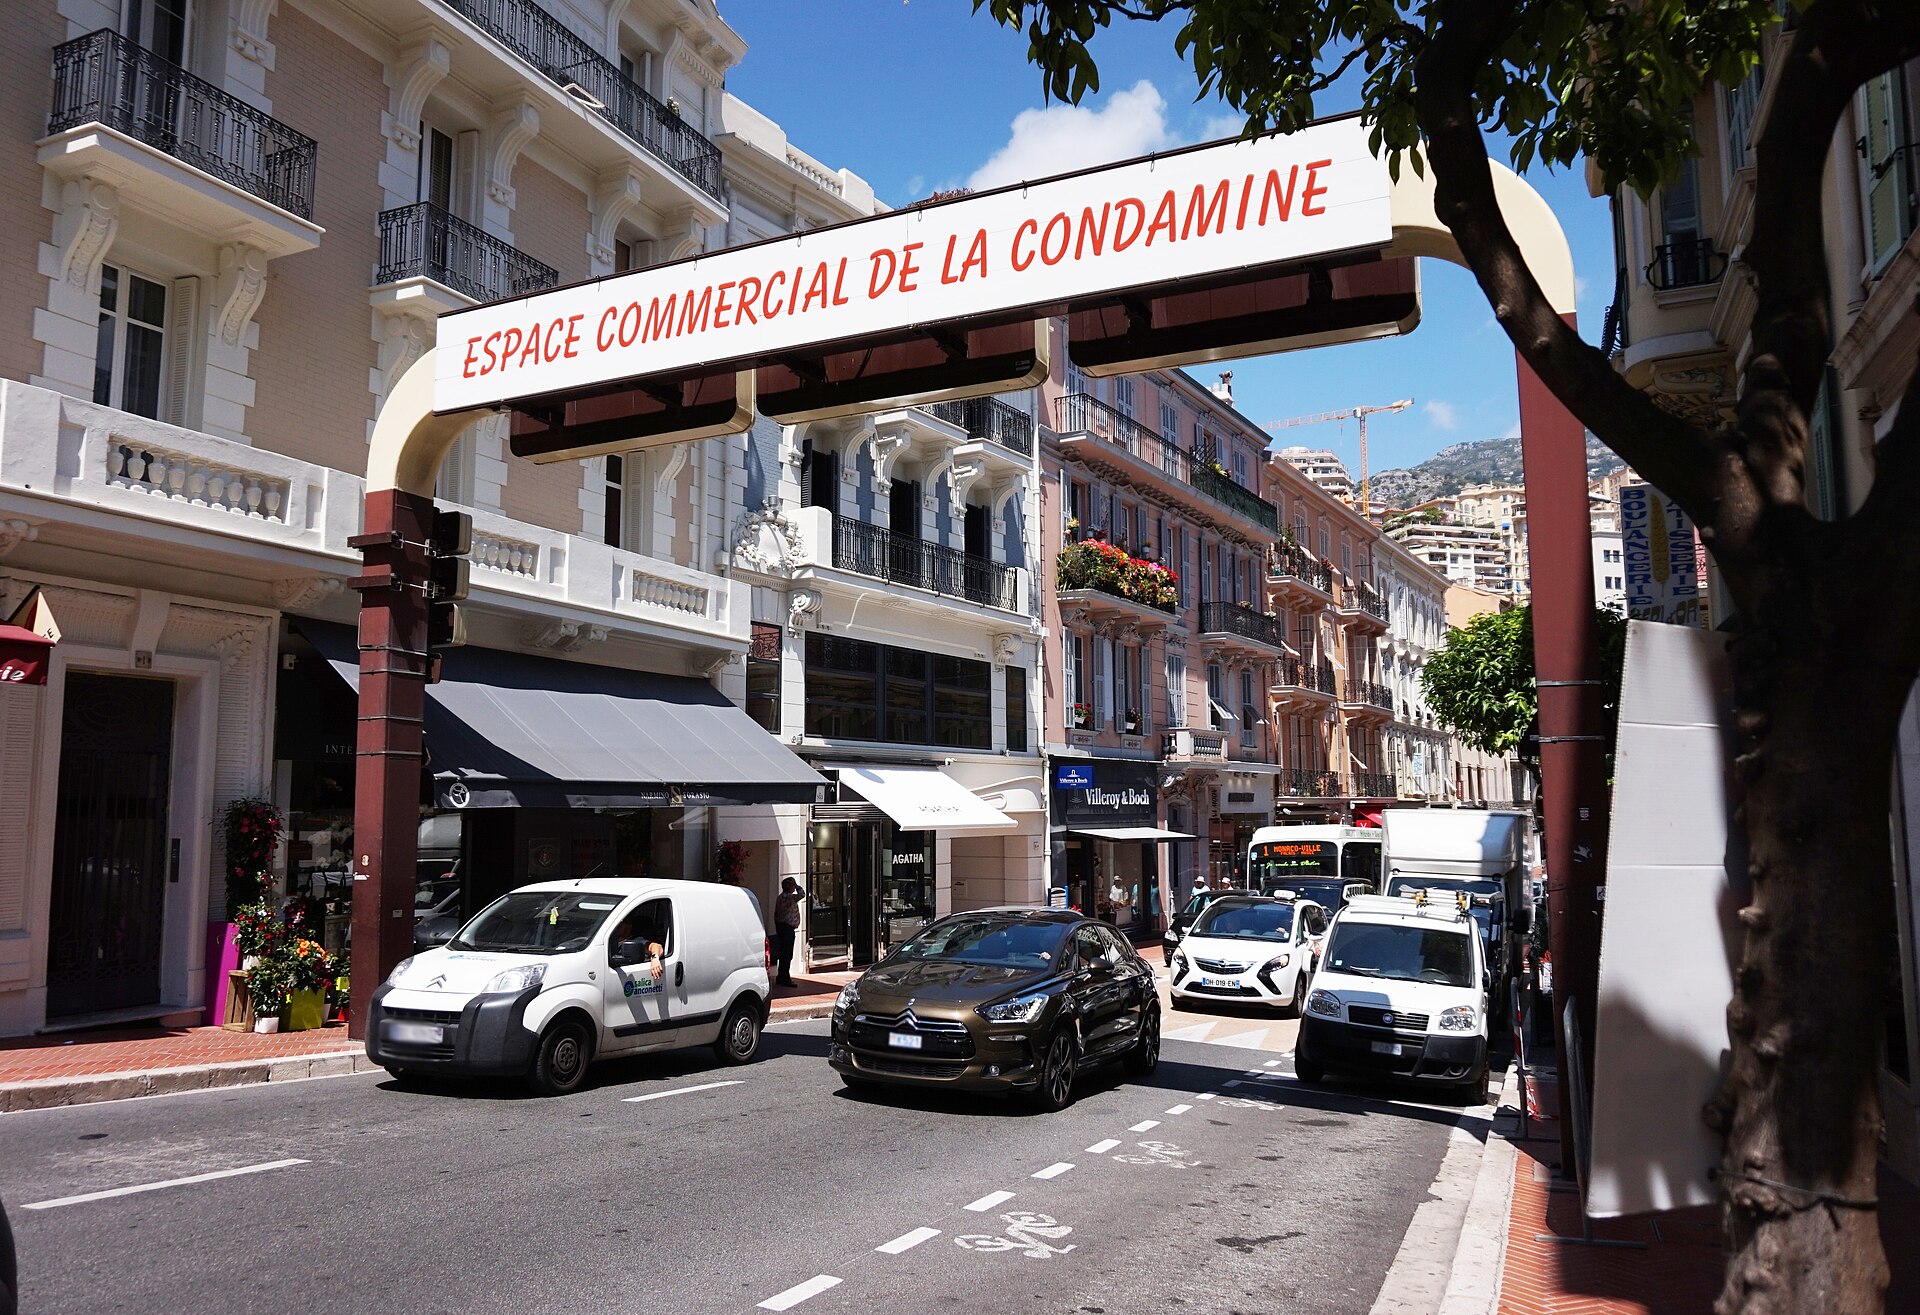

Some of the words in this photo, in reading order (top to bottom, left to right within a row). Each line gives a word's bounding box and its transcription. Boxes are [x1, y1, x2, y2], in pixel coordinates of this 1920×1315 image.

[463, 313, 585, 379] ESPACE
[596, 256, 849, 353] COMMERCIAL
[867, 241, 924, 300] DE
[940, 227, 987, 286] LA
[1010, 158, 1333, 273] CONDAMINE
[1623, 489, 1652, 606] BOULANGERIE
[1666, 501, 1698, 597] TISSERIE
[1085, 787, 1121, 810] Villeroy
[1121, 790, 1129, 805] &
[1129, 788, 1150, 805] Boch
[892, 853, 924, 865] AGATHA
[1263, 845, 1270, 857] 1
[1273, 844, 1322, 853] MONACO-VILLE
